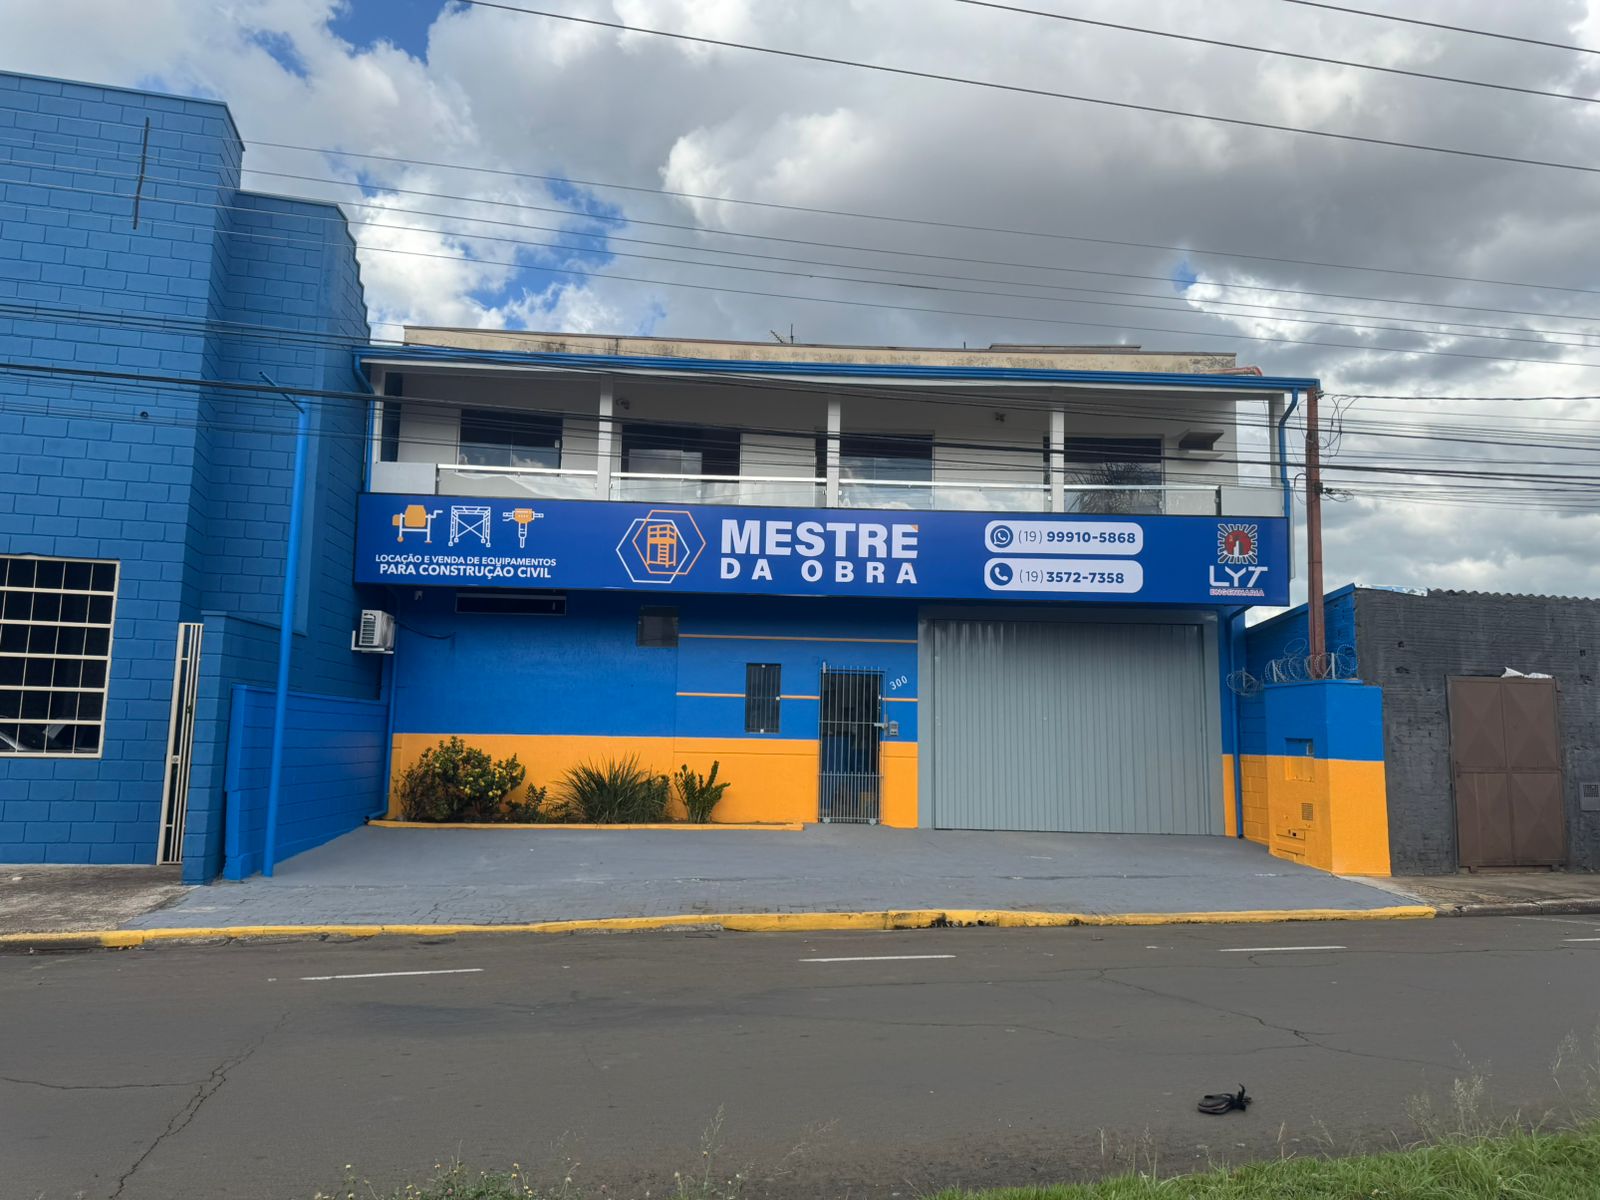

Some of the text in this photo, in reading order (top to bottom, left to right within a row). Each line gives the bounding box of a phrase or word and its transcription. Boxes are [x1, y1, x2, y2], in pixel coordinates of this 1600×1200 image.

[721, 519, 918, 558] MESTRE
[1018, 530, 1136, 545] (19) 99910-5868
[375, 554, 556, 566] LOCAÇÃO E VENDA DE EQUIPAMENTOS
[380, 563, 551, 579] PARA CONSTRUÇÃO CIVIL
[720, 558, 917, 584] DA OBRA
[1019, 569, 1125, 584] (19) 3572-7358
[889, 675, 908, 690] 300
